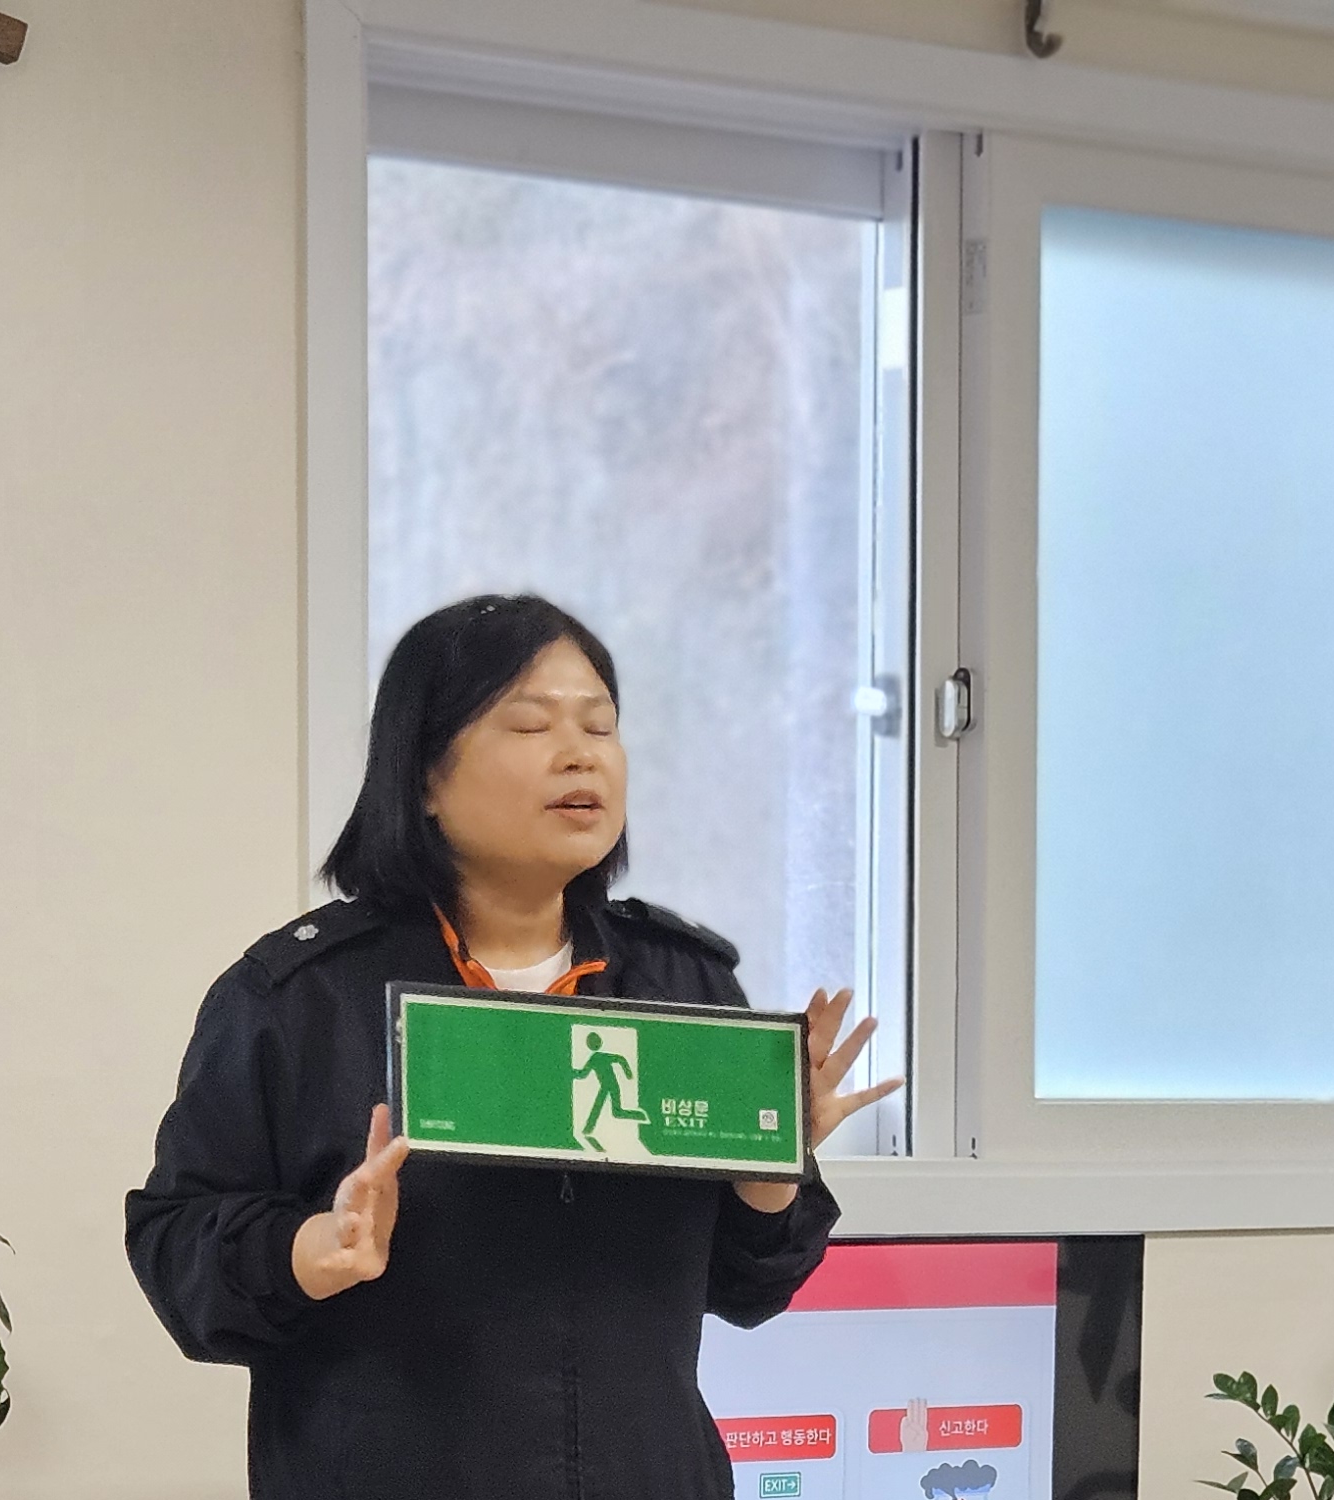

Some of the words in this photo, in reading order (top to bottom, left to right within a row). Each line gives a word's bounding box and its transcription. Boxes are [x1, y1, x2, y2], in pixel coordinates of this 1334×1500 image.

[662, 1098, 708, 1117] 비상문
[665, 1116, 707, 1128] EXIT
[938, 1419, 989, 1437] 신고한다
[726, 1430, 777, 1449] 판단하고
[780, 1427, 832, 1446] 행동한다
[764, 1479, 788, 1493] EXIT
